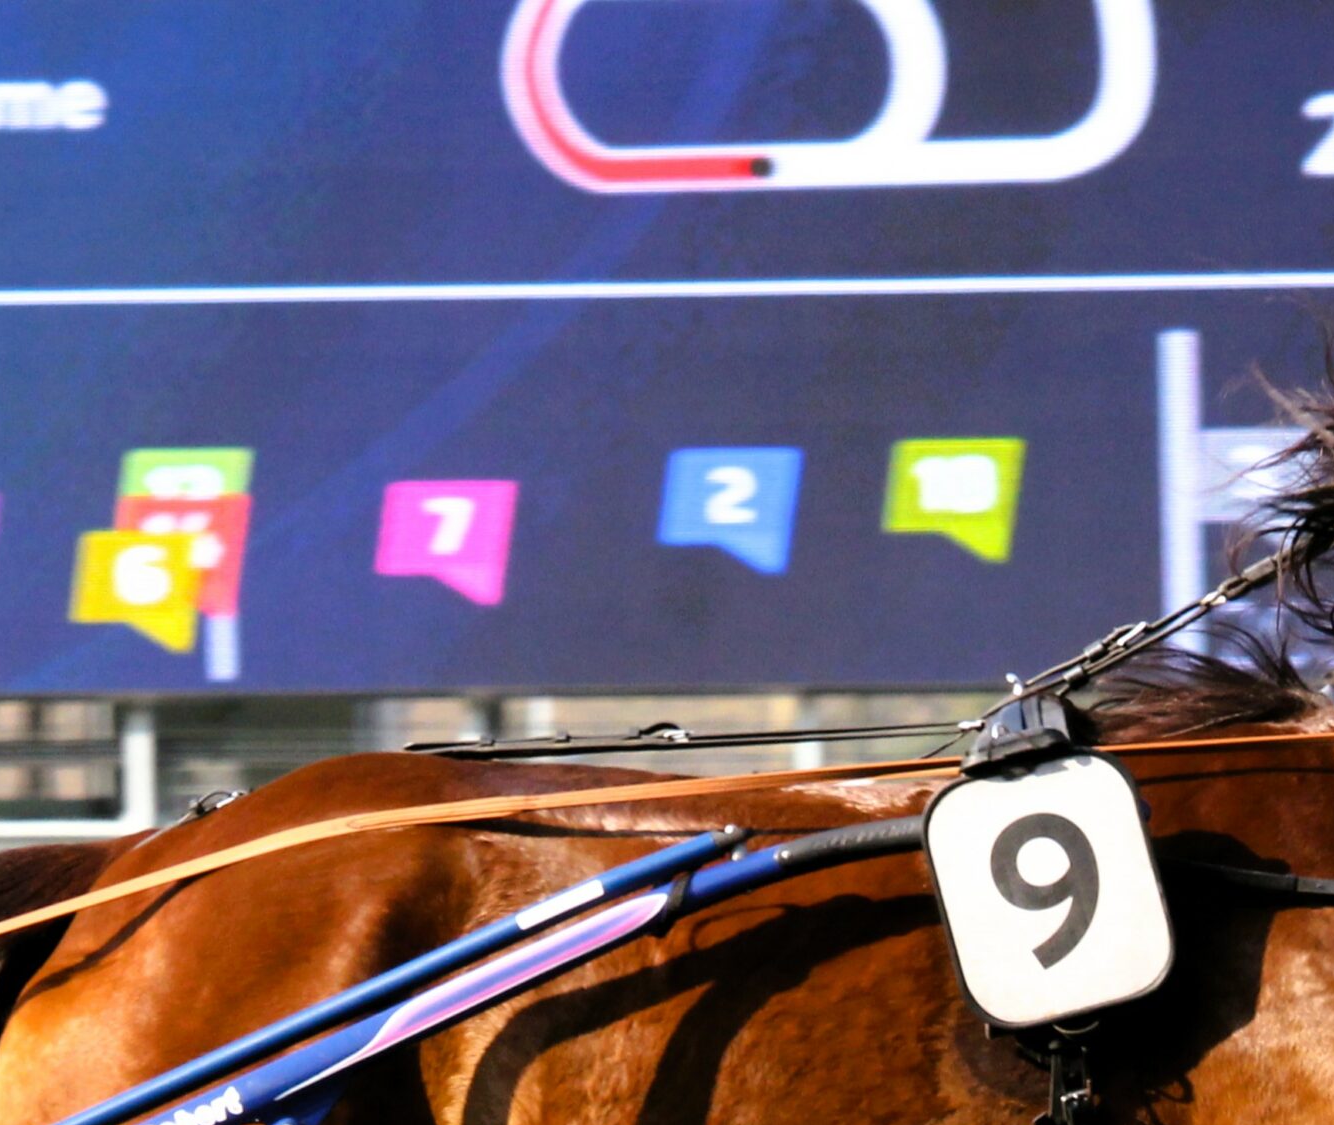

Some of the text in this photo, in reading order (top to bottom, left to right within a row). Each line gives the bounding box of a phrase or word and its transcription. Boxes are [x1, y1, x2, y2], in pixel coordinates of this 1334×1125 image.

[704, 466, 758, 525] 2
[422, 497, 474, 555] 7
[112, 544, 172, 606] 6
[989, 811, 1100, 971] 9
